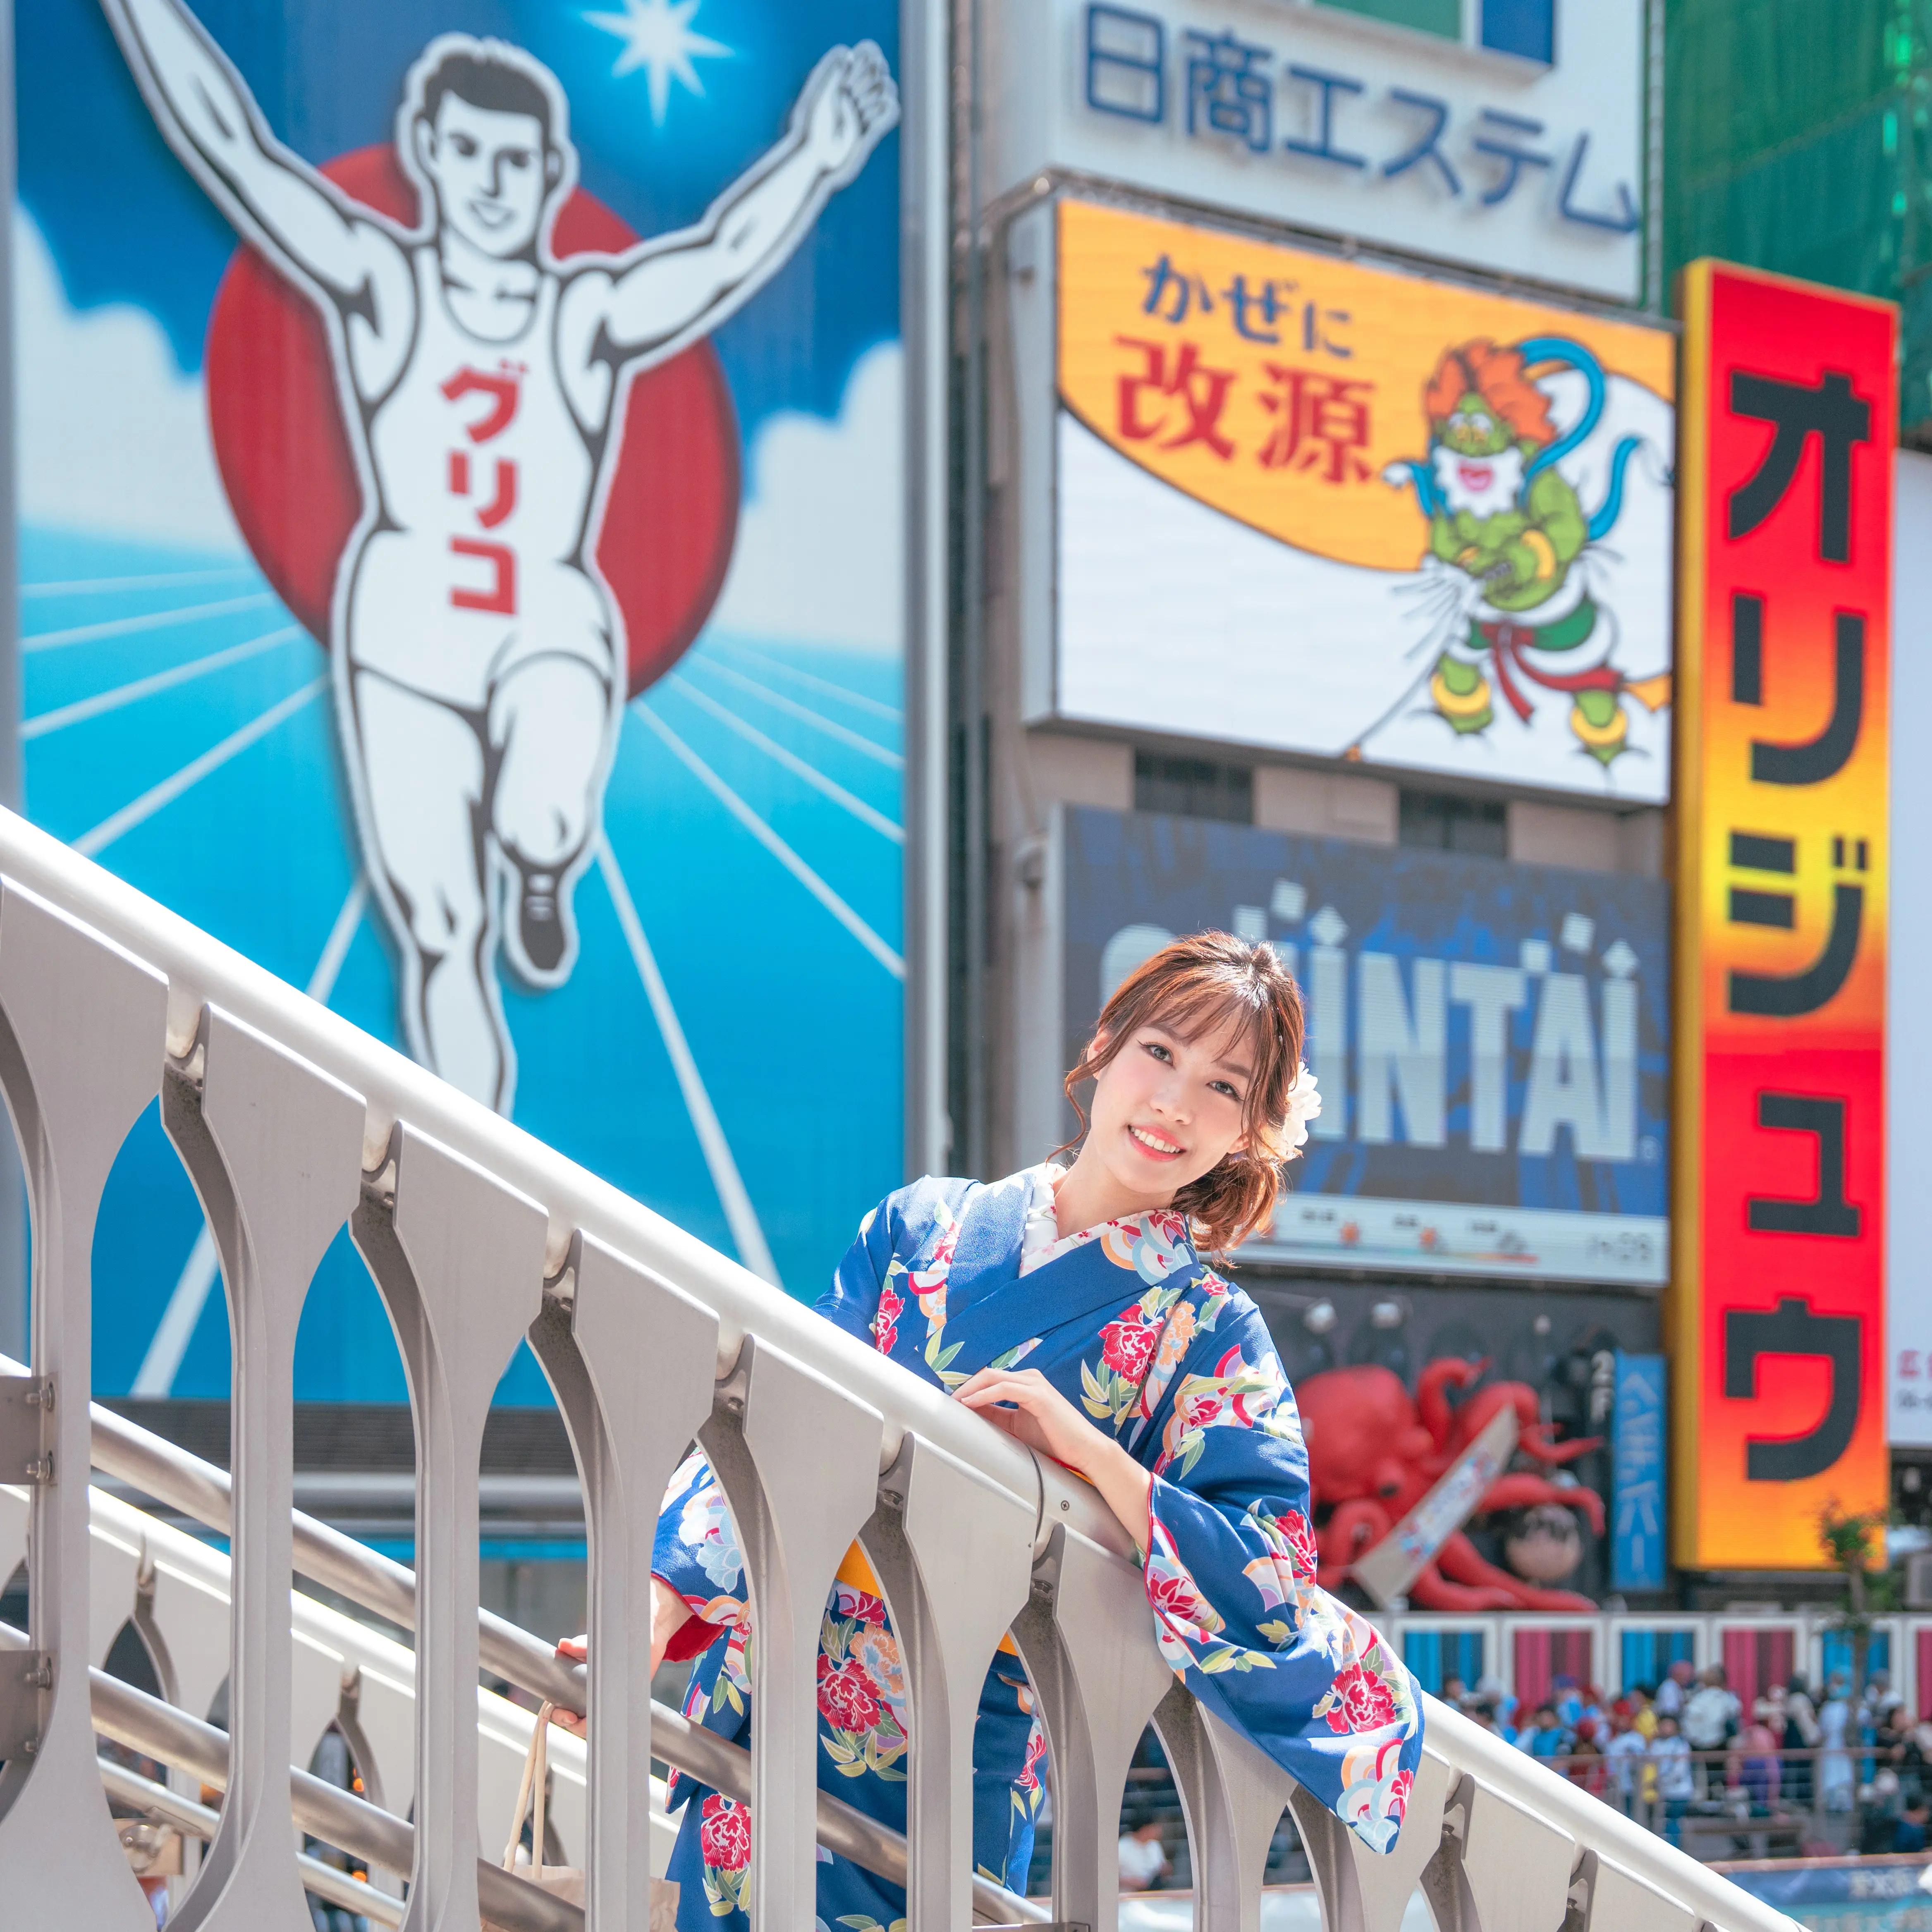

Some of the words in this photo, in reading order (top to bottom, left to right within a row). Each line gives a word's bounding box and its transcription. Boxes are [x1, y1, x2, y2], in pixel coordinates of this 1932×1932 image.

[1086, 3, 1639, 234] 日商エステム
[1113, 334, 1375, 483] 改源
[1142, 253, 1353, 359] かぜに
[440, 359, 528, 616] グリコ
[1099, 878, 1640, 1160] INTAI
